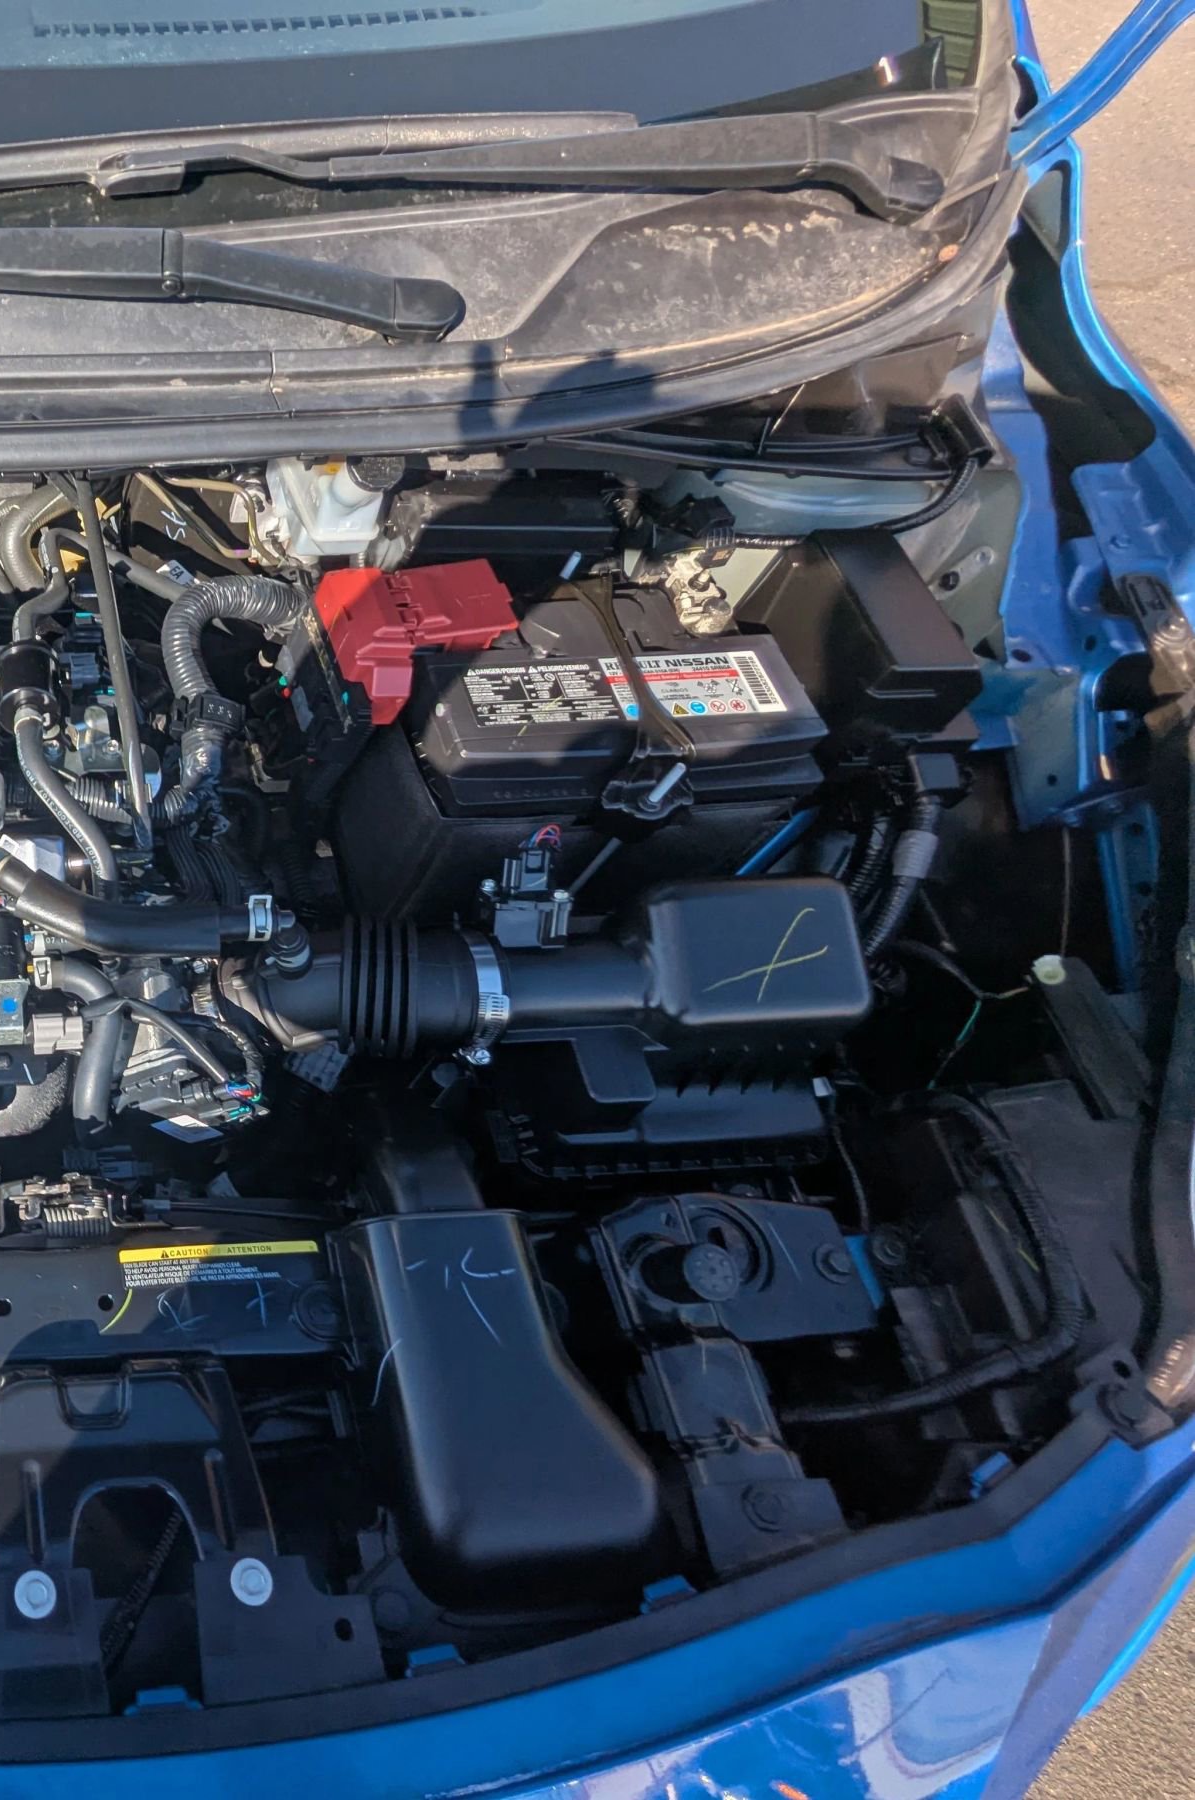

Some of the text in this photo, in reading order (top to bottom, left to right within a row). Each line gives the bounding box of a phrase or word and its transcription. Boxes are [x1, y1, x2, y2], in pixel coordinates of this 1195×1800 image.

[169, 566, 184, 580] EA
[604, 659, 662, 671] REULT
[665, 656, 729, 667] NISSAN
[169, 1245, 272, 1257] CAUTION ATTENTION
[131, 1272, 164, 1280] VENTILATEUR
[164, 1270, 183, 1278] RISQUE
[125, 1279, 140, 1287] POUR
[158, 1277, 175, 1285] TOUTE
